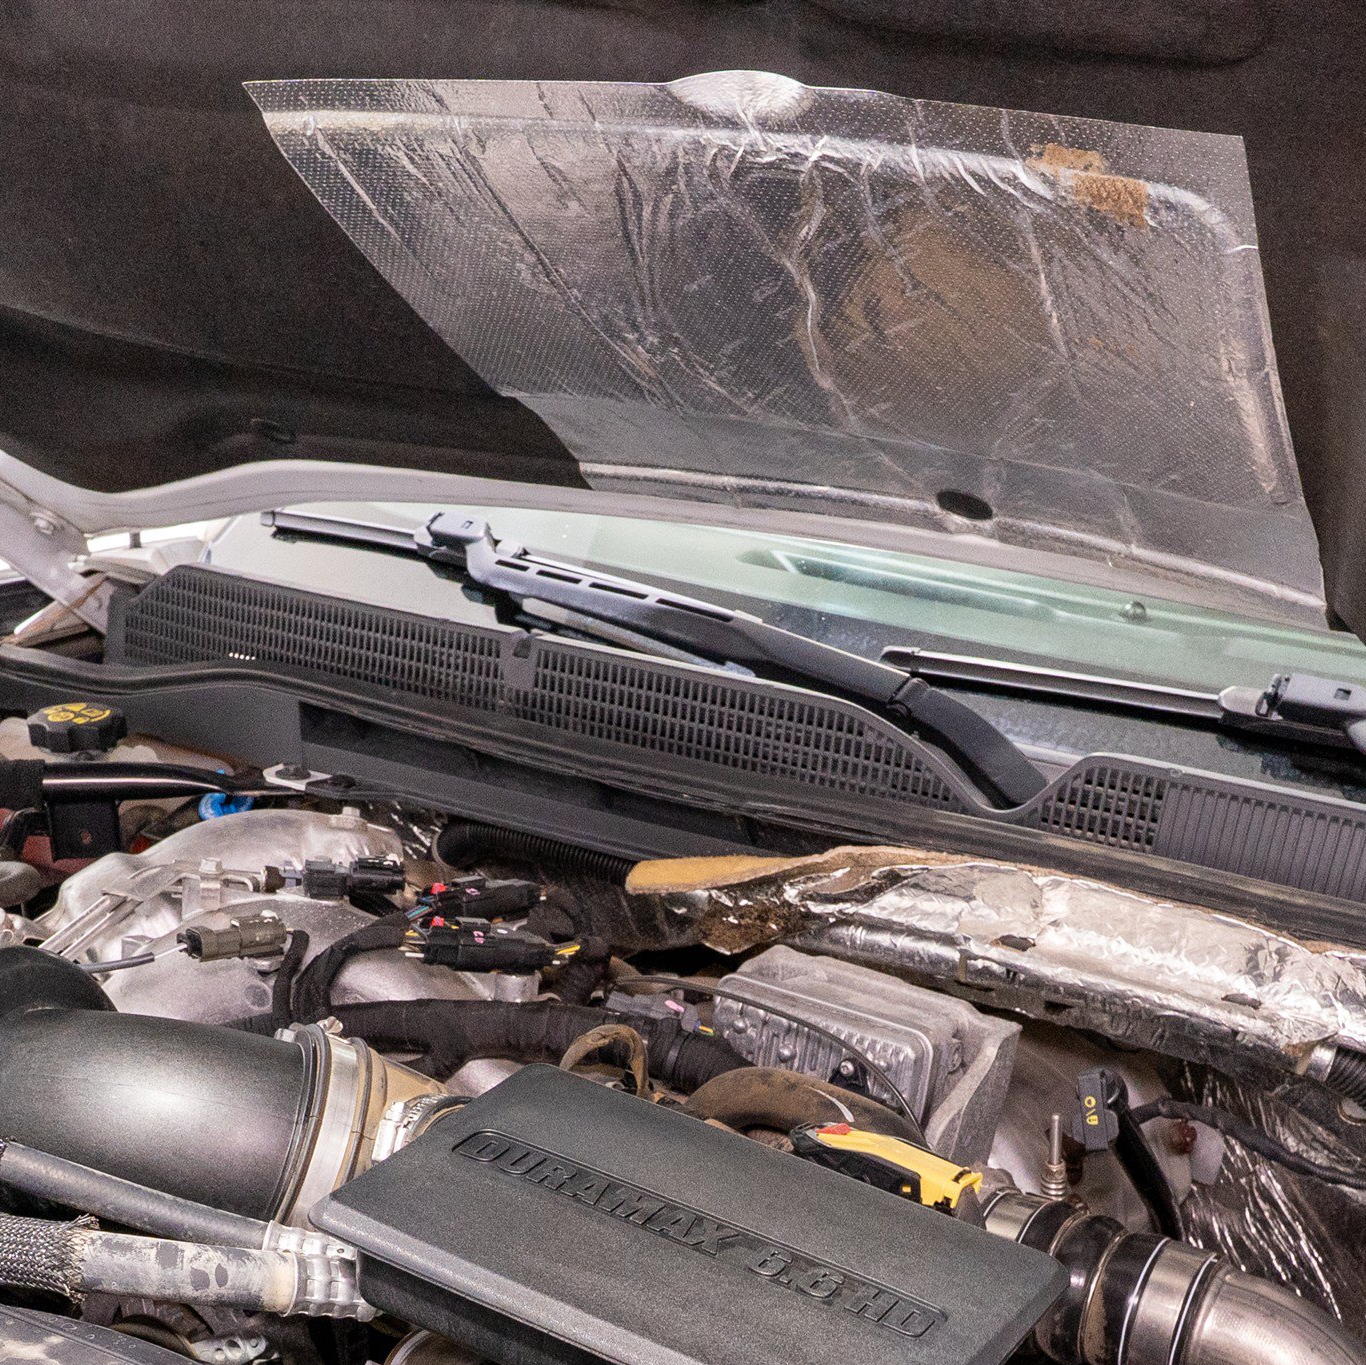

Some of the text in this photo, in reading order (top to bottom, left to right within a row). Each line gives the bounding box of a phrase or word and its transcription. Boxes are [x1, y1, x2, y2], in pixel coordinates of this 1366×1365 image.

[458, 1130, 939, 1339] DURAMAX 6.6 HD
